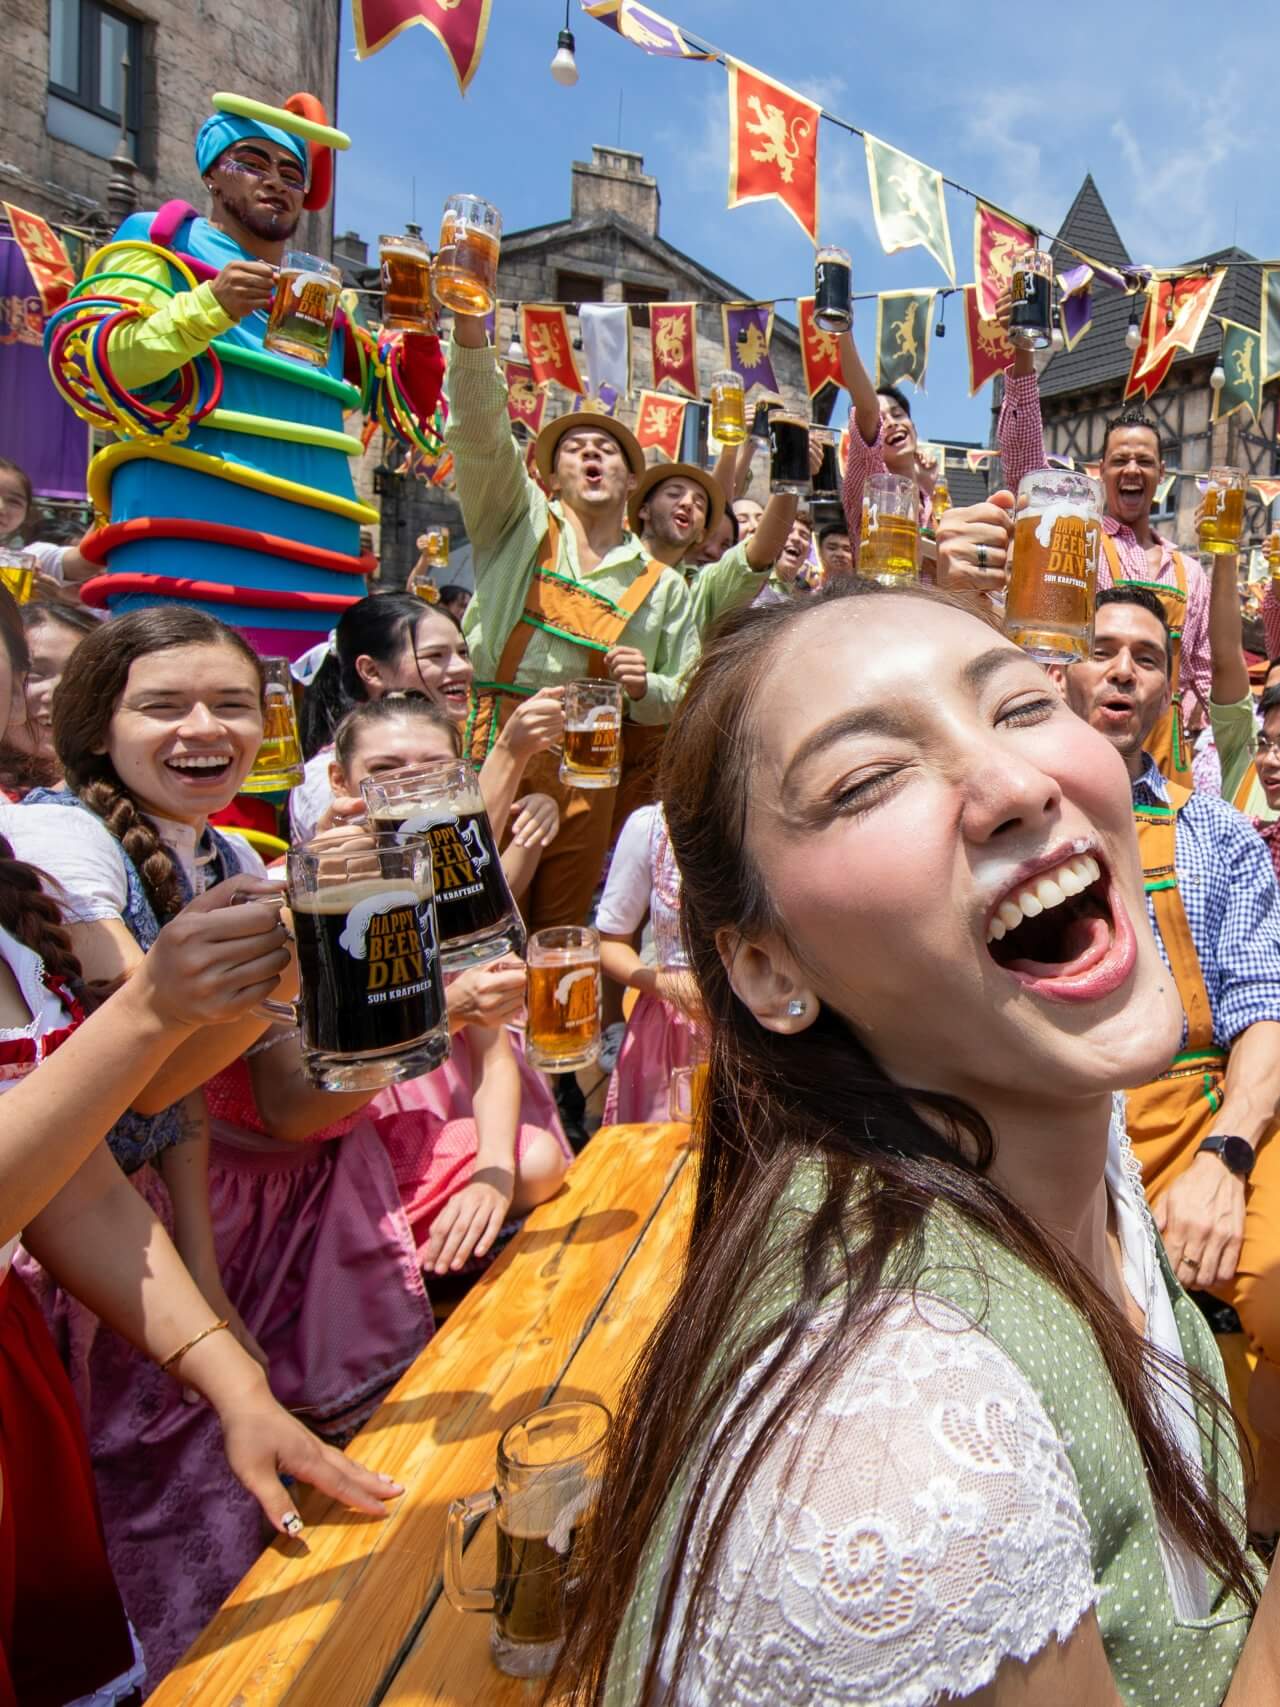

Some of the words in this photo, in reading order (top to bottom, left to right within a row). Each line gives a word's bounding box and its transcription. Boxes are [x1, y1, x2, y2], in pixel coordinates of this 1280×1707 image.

[1055, 518, 1084, 537] HAPPY
[1051, 533, 1085, 556] BEER
[1047, 552, 1085, 577] DAY
[431, 844, 470, 868] EER
[443, 883, 484, 900] KRAFTBEER
[370, 909, 415, 937] HAPPY
[368, 929, 420, 962] BEER
[367, 952, 425, 990] DAY
[389, 980, 432, 1000] KRAFTBEER
